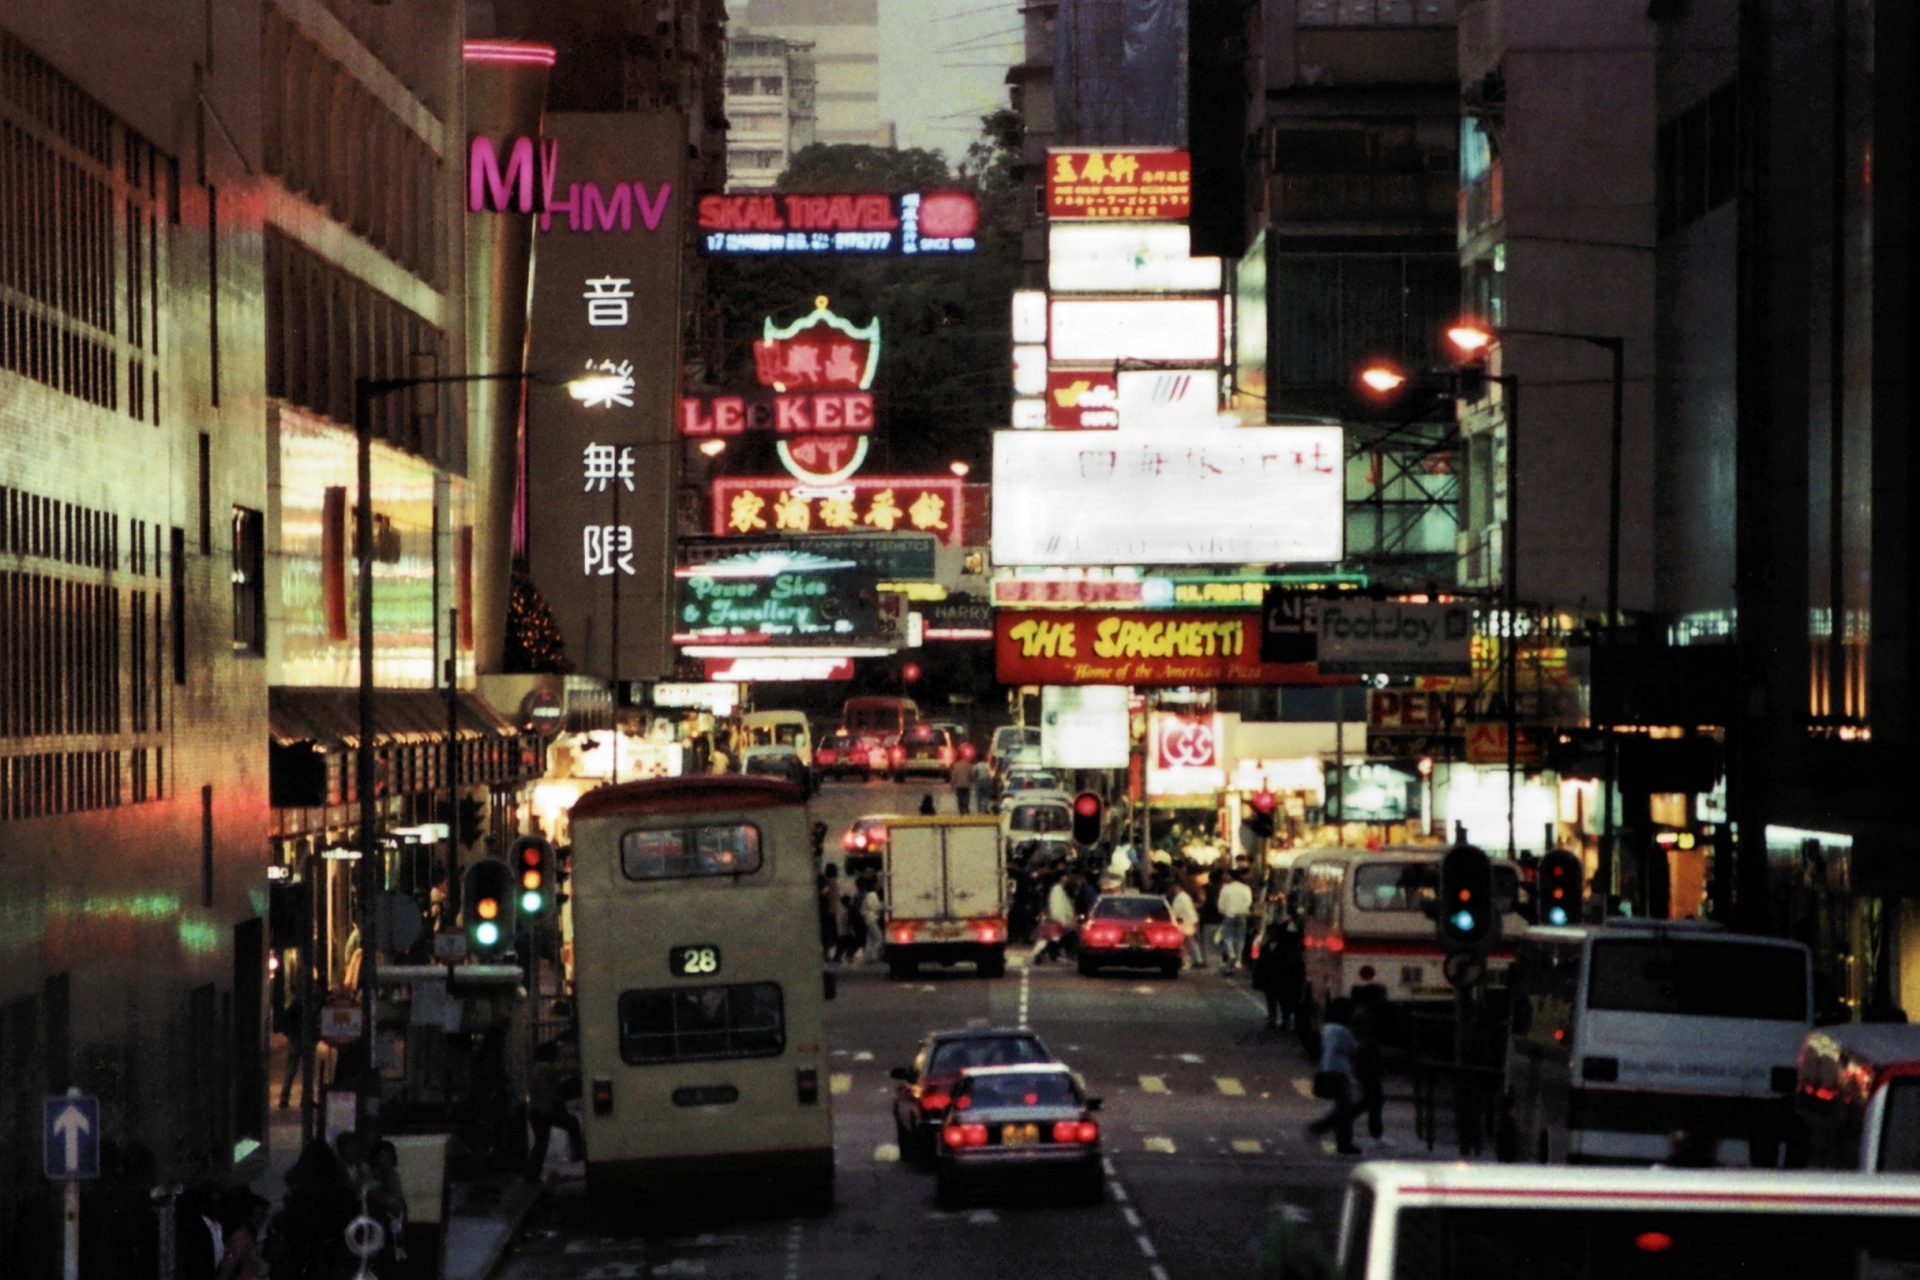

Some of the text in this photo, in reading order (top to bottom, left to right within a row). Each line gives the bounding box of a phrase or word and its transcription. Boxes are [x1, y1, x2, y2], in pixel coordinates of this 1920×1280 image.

[541, 181, 671, 231] HMV
[785, 194, 898, 229] TRAVEL
[707, 233, 725, 250] 17
[776, 395, 872, 429] KEE
[688, 574, 828, 600] Power Shoe
[708, 600, 811, 626] Jewellery
[1010, 620, 1077, 657] THE
[1115, 663, 1132, 680] of
[1135, 663, 1153, 679] the
[1159, 664, 1221, 680] American
[683, 949, 717, 974] 28
